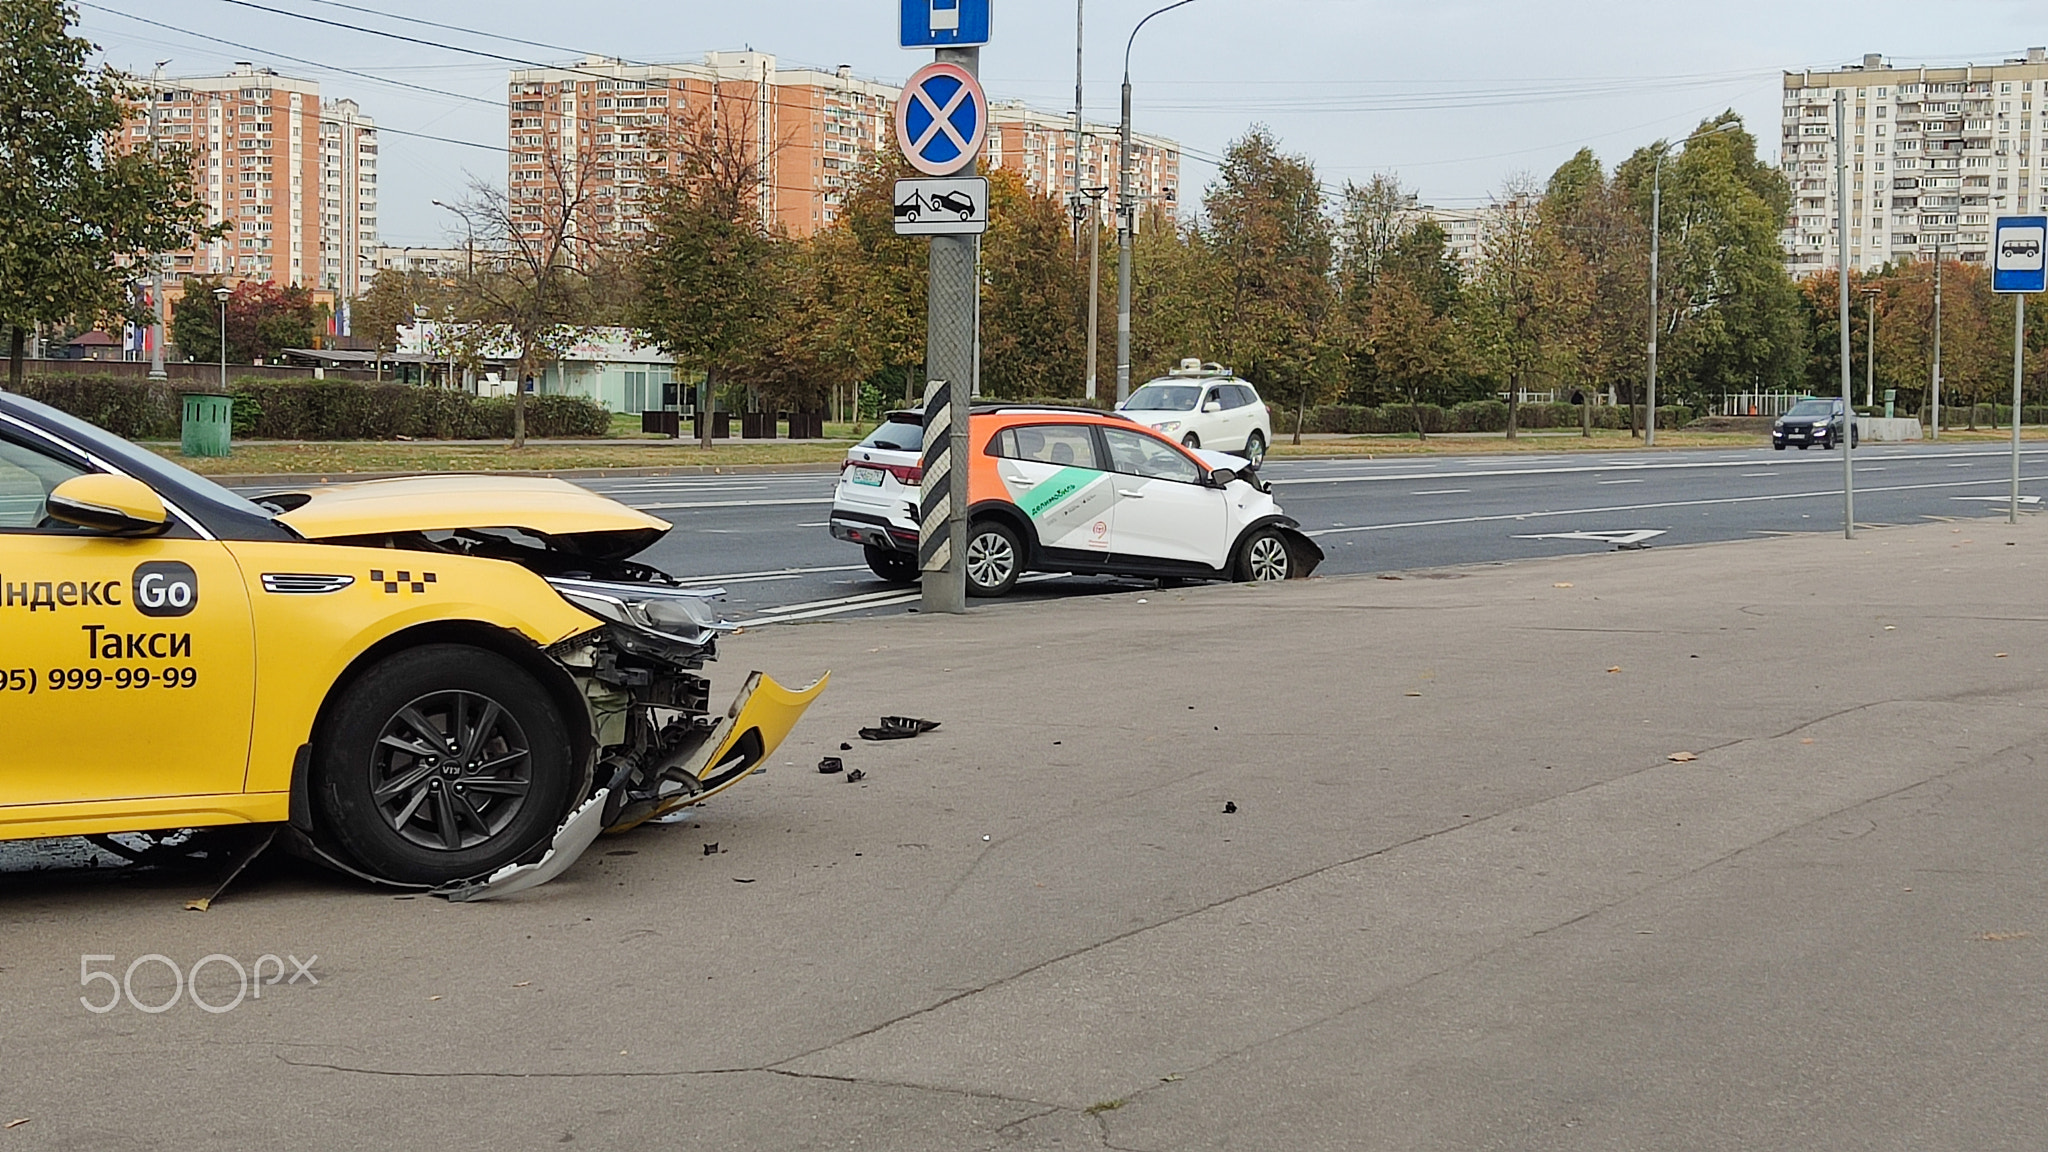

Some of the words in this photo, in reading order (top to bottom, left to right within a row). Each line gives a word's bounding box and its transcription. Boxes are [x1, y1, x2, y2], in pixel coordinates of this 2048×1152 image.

[0, 573, 121, 612] ндекс
[139, 573, 191, 608] Go
[81, 625, 191, 659] Такси
[48, 667, 197, 690] 999-99-99
